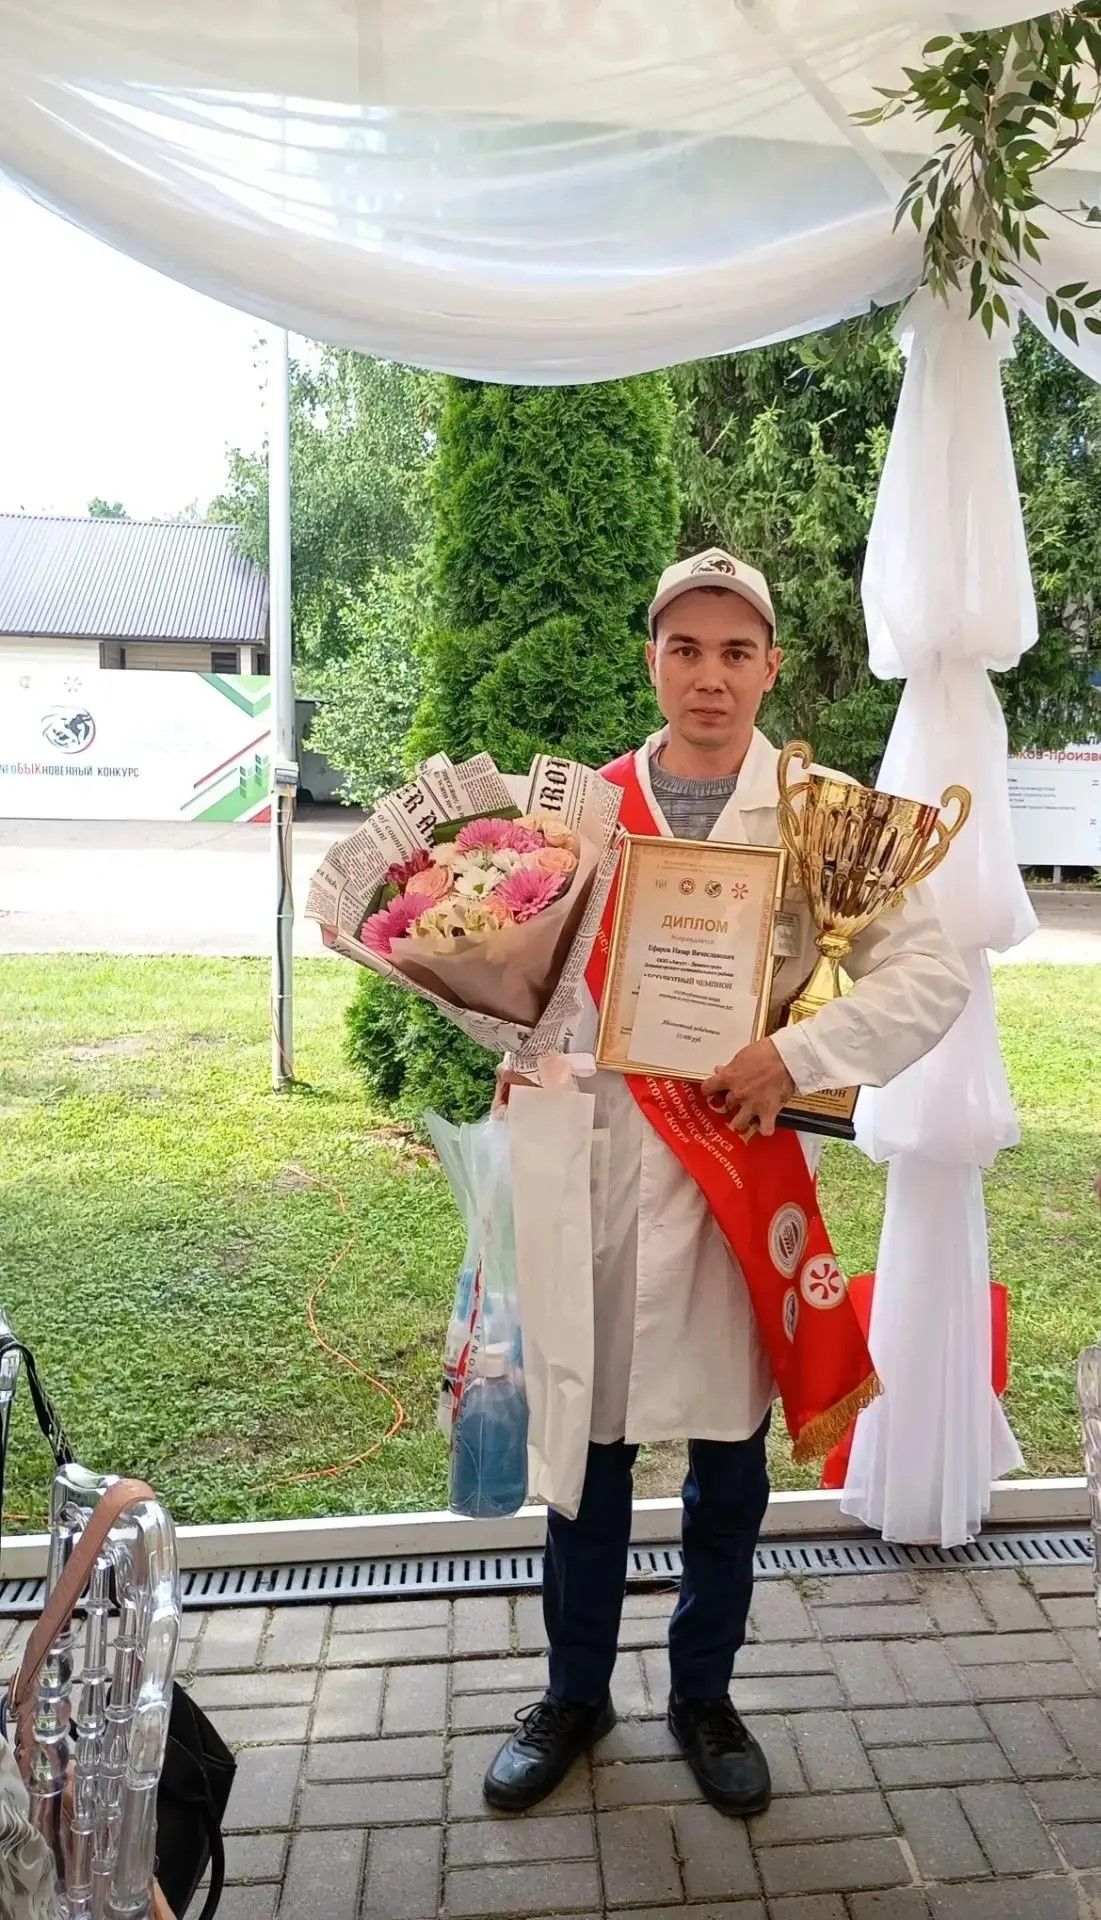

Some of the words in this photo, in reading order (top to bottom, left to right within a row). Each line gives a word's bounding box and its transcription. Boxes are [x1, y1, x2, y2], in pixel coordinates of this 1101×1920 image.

[97, 767, 140, 777] КОНКУРС
[661, 914, 729, 934] ДИПЛОМ
[686, 1121, 744, 1189] осеменению
